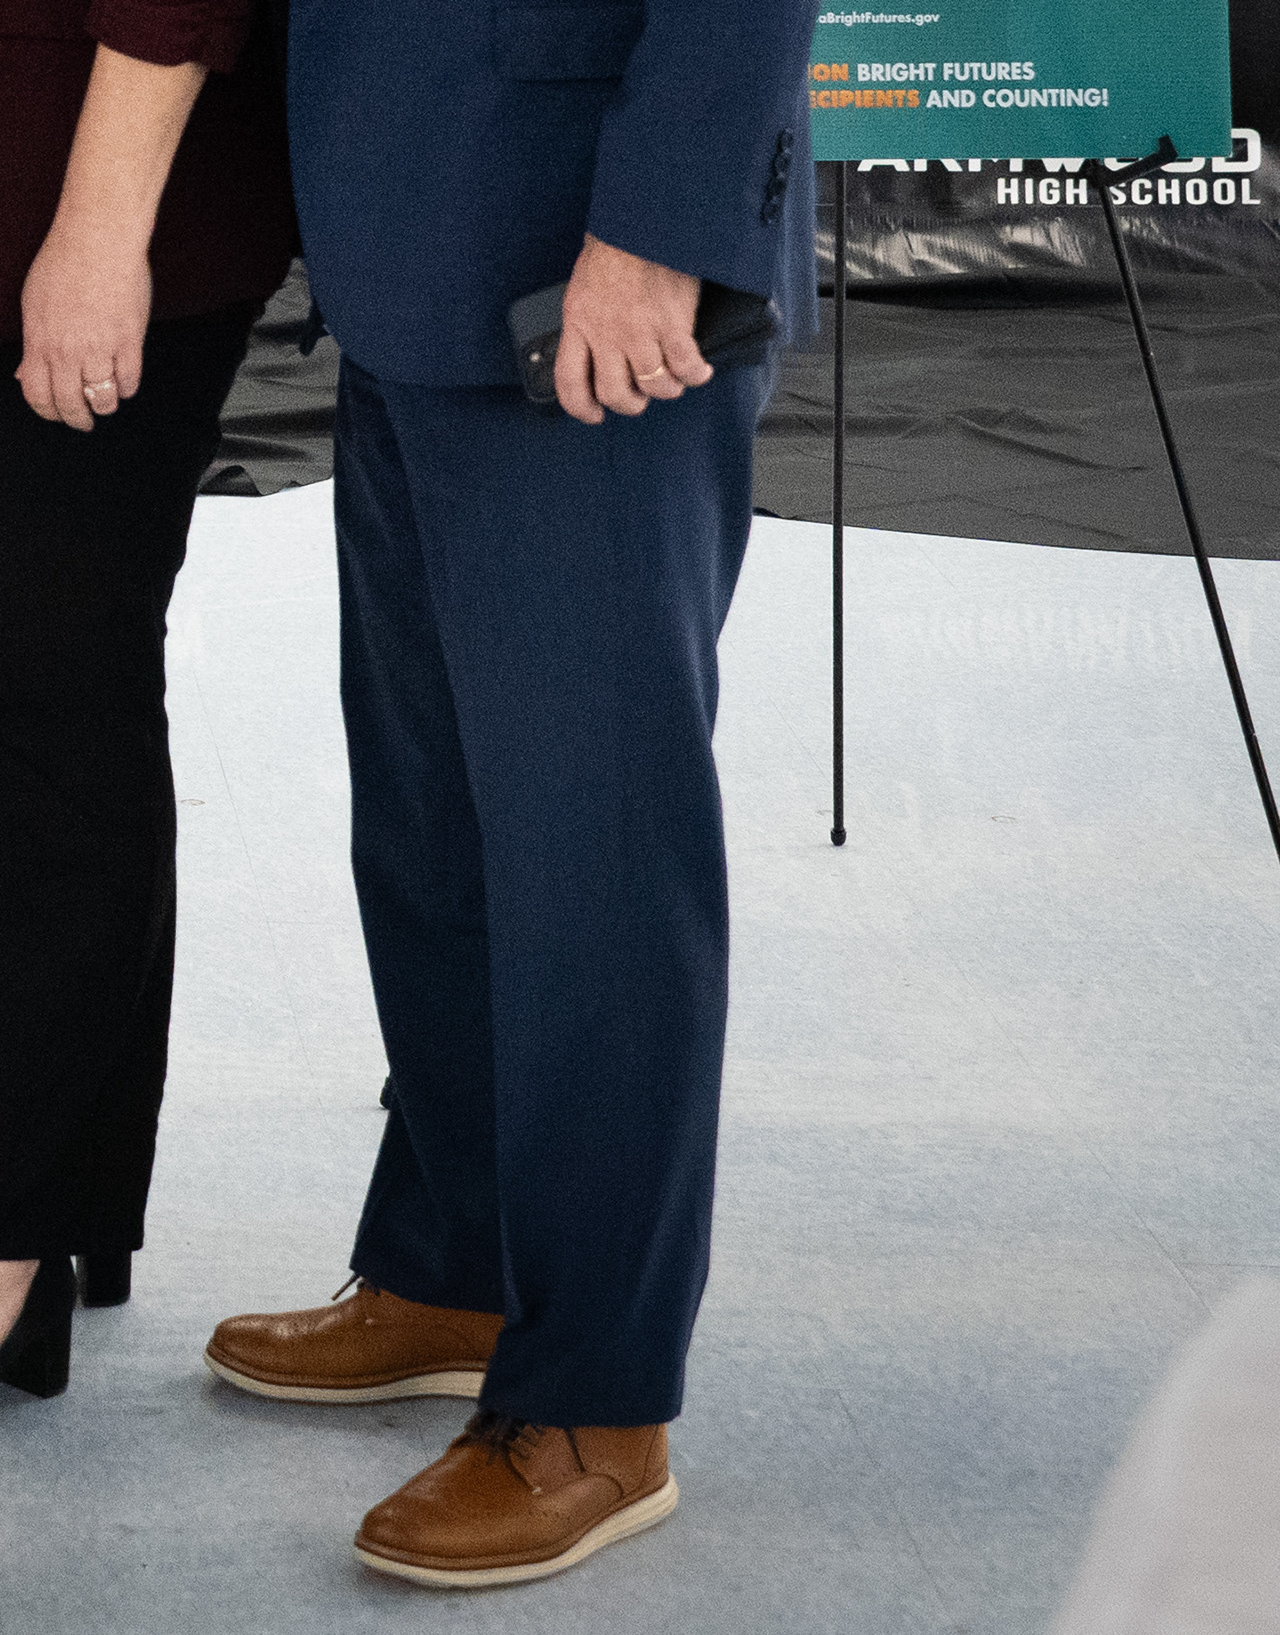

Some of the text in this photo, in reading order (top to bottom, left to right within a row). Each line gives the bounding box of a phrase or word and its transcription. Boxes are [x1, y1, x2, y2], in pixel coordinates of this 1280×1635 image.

[857, 63, 937, 82] BRIGHT
[943, 61, 1035, 81] FUTURES
[926, 90, 976, 108] AND
[982, 88, 1109, 108] COUNTING!
[997, 177, 1262, 206] HIGH SCHOOL
